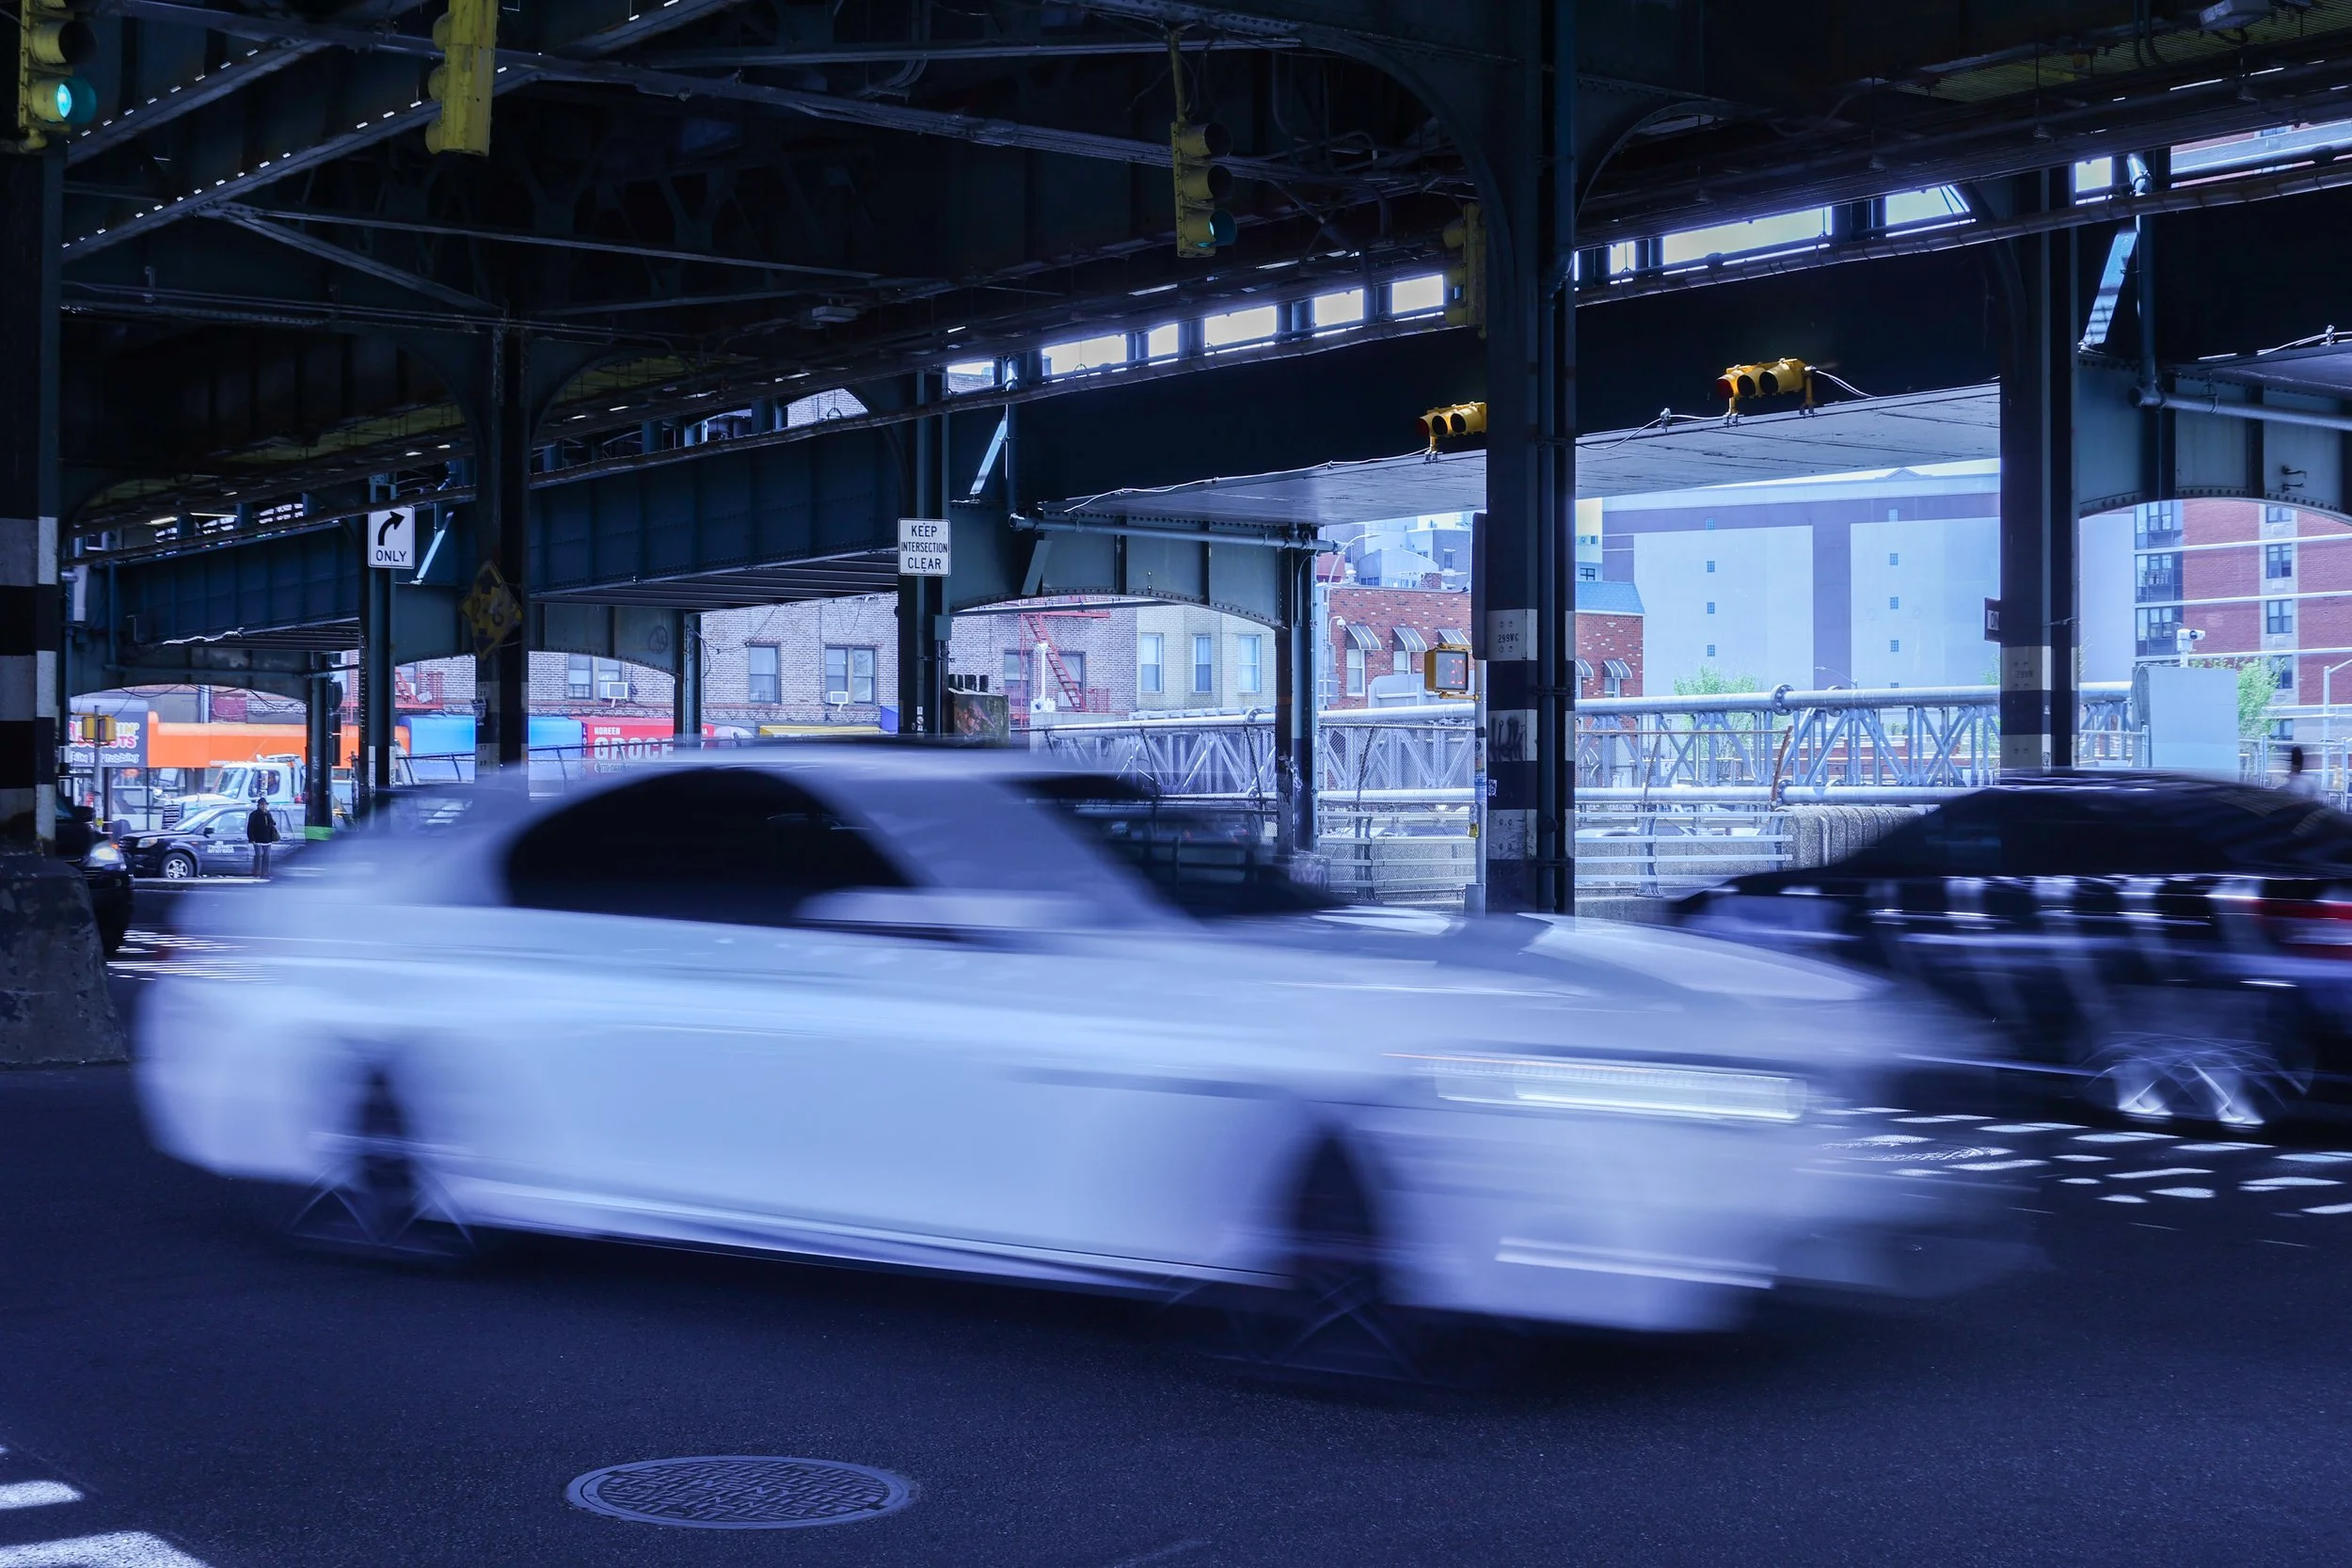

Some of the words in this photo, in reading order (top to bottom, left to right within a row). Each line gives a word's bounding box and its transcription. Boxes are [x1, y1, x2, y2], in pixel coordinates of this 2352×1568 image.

[911, 525, 938, 537] KEEP
[900, 541, 948, 553] INTERSECTION
[376, 549, 407, 562] ONLY
[907, 557, 942, 570] CLEAR
[618, 1487, 692, 1498] MADE
[733, 1500, 807, 1515] INDIA
